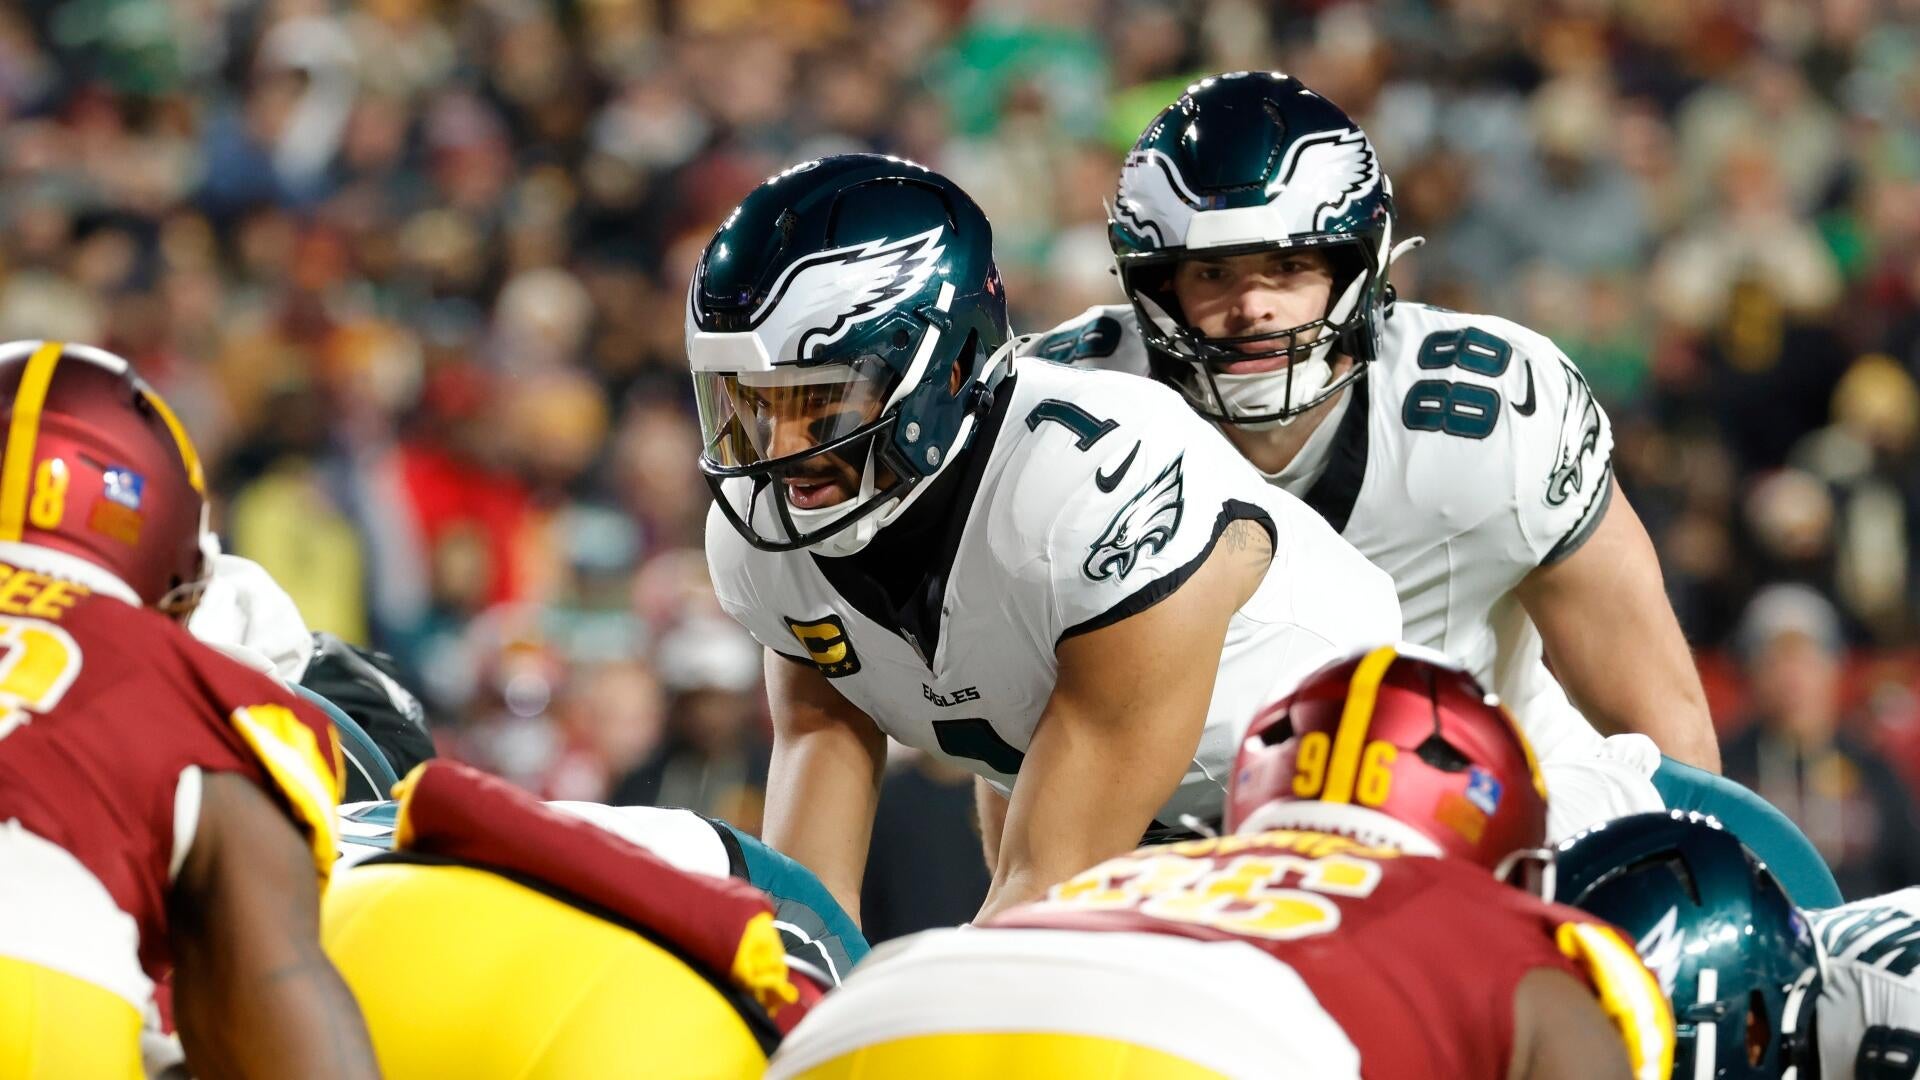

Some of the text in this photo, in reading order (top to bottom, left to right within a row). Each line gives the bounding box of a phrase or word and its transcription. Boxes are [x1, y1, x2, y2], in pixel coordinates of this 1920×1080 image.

[1402, 326, 1513, 440] 88
[1025, 399, 1120, 452] 1
[29, 457, 69, 530] 8
[0, 564, 92, 620] EE
[790, 623, 847, 664] C
[921, 682, 981, 708] EAGLES
[1291, 731, 1399, 808] 96
